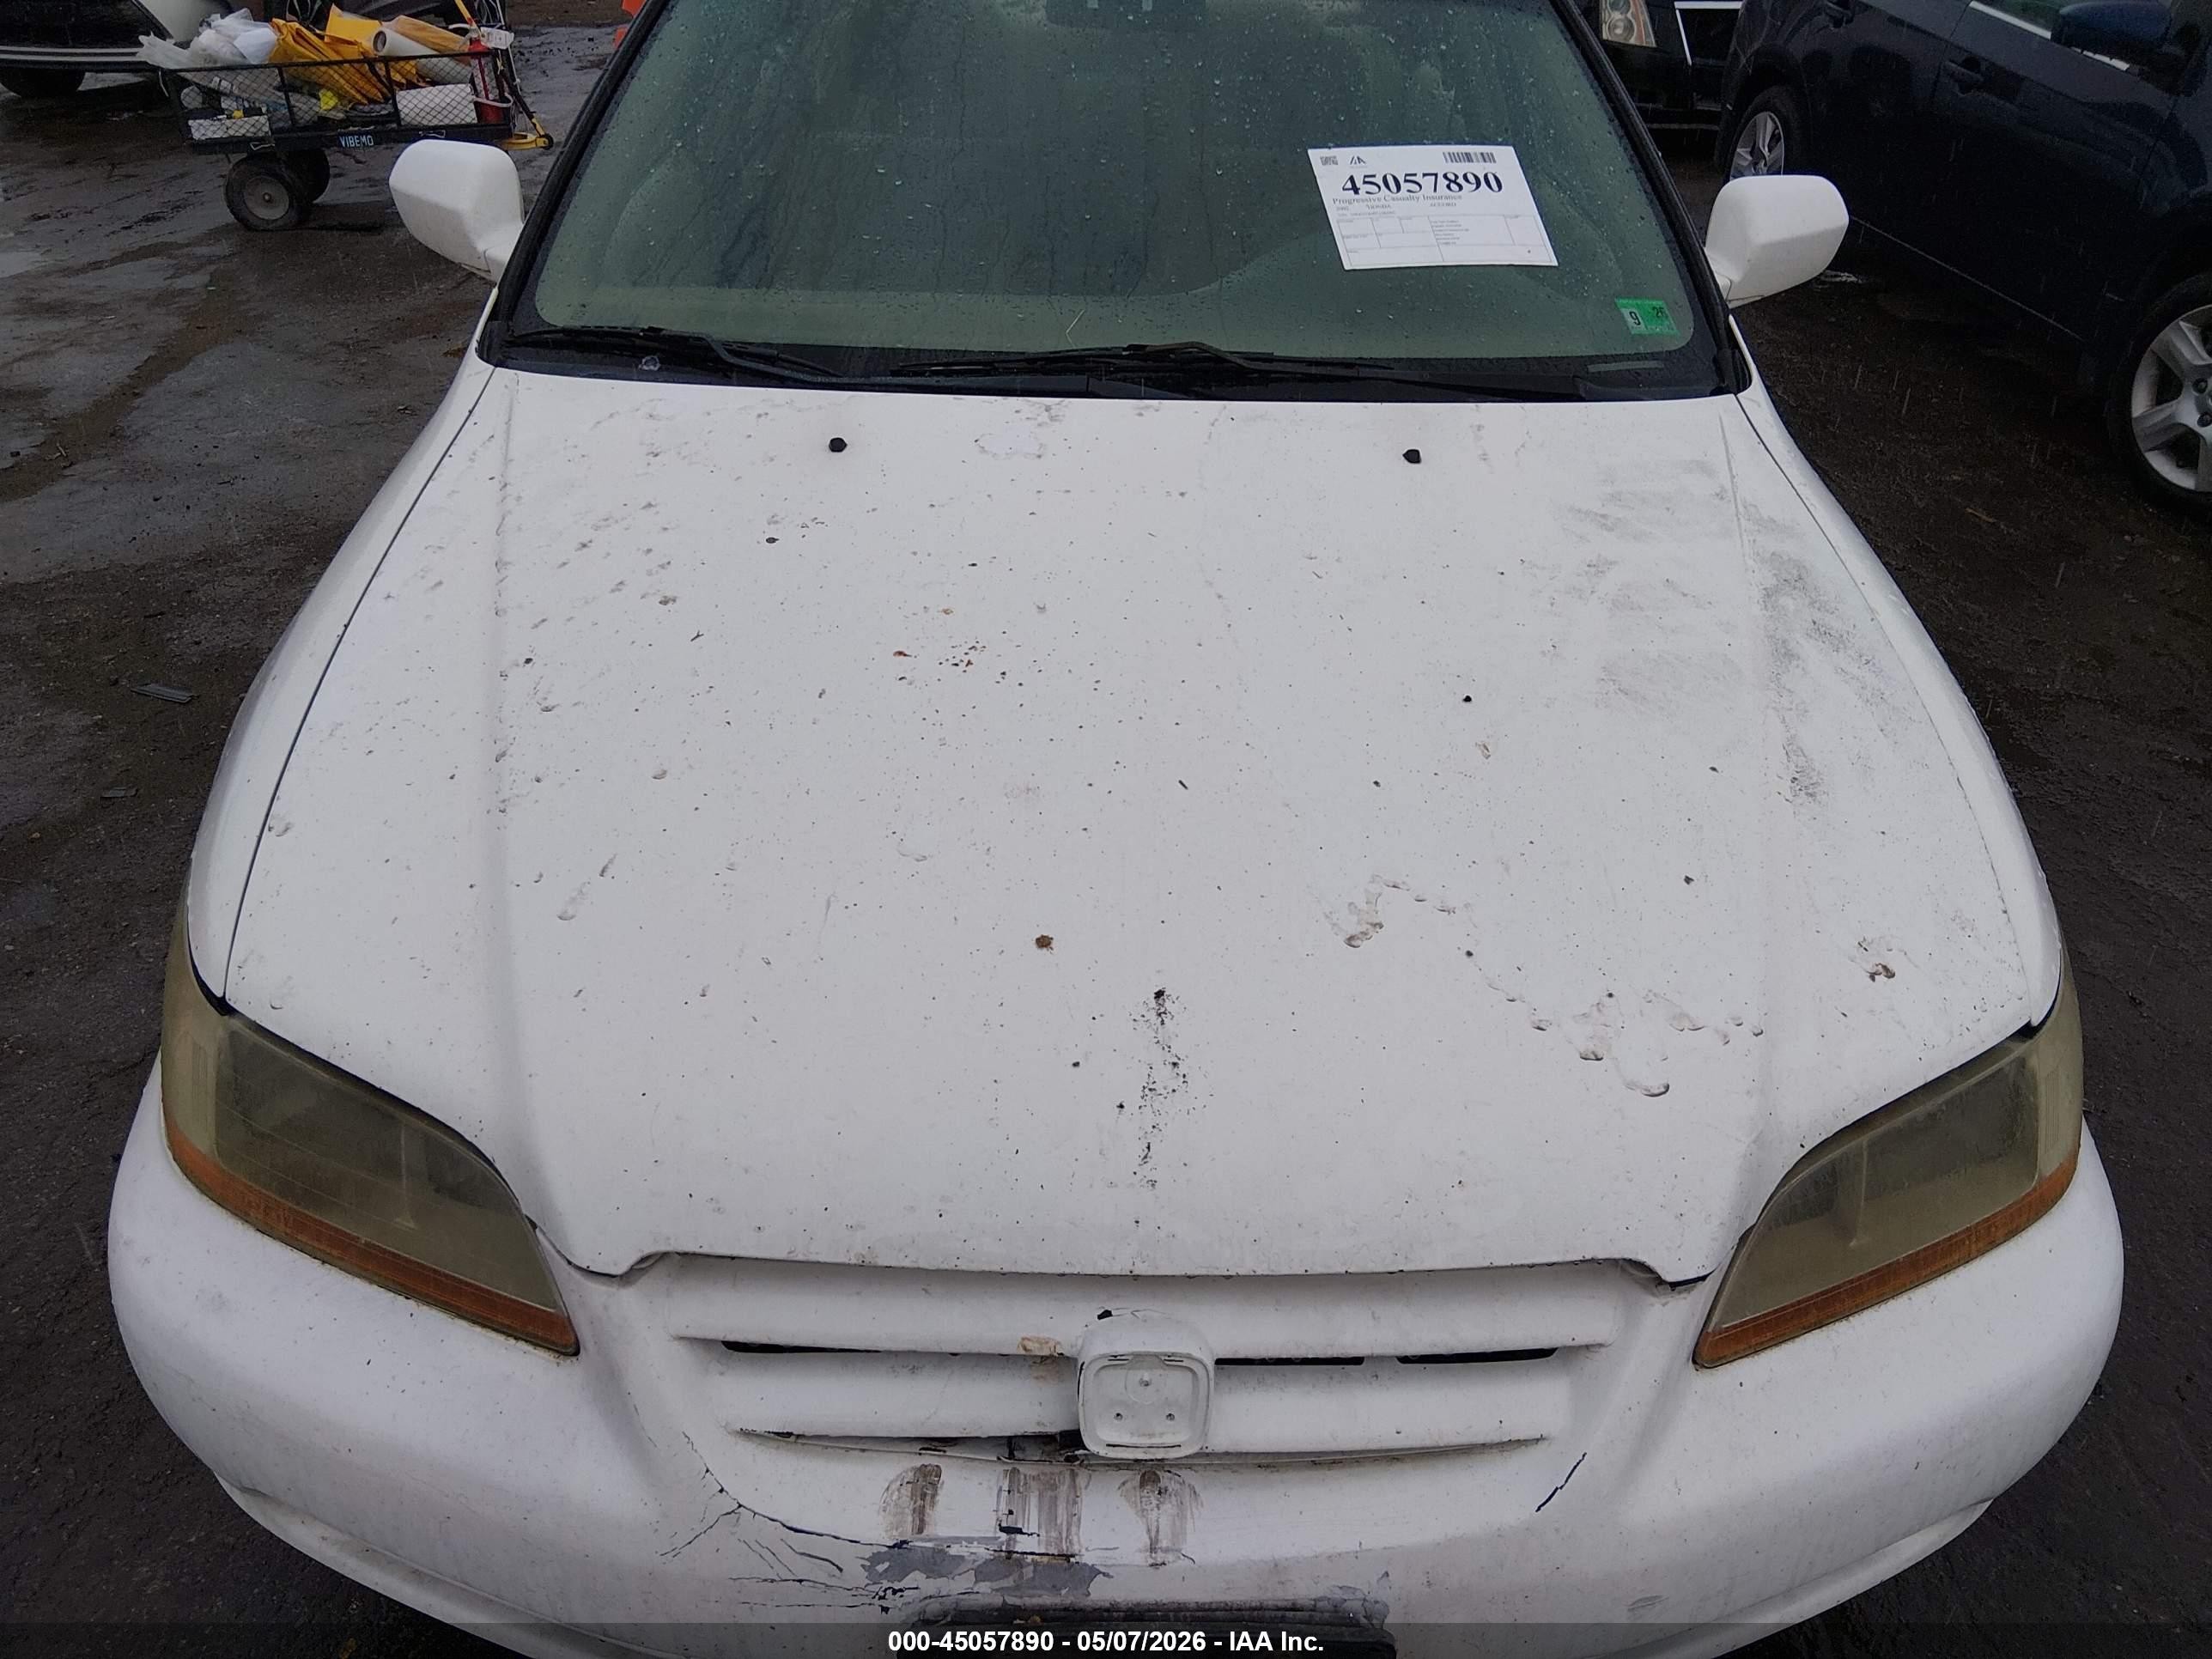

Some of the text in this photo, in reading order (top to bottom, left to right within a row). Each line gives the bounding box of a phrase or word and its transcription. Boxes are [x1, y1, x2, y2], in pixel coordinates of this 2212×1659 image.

[339, 135, 374, 148] VIBEMO
[1341, 171, 1504, 196] 45057890
[1332, 193, 1463, 206] Progressive Casualty Insurance
[1629, 311, 1641, 326] 9
